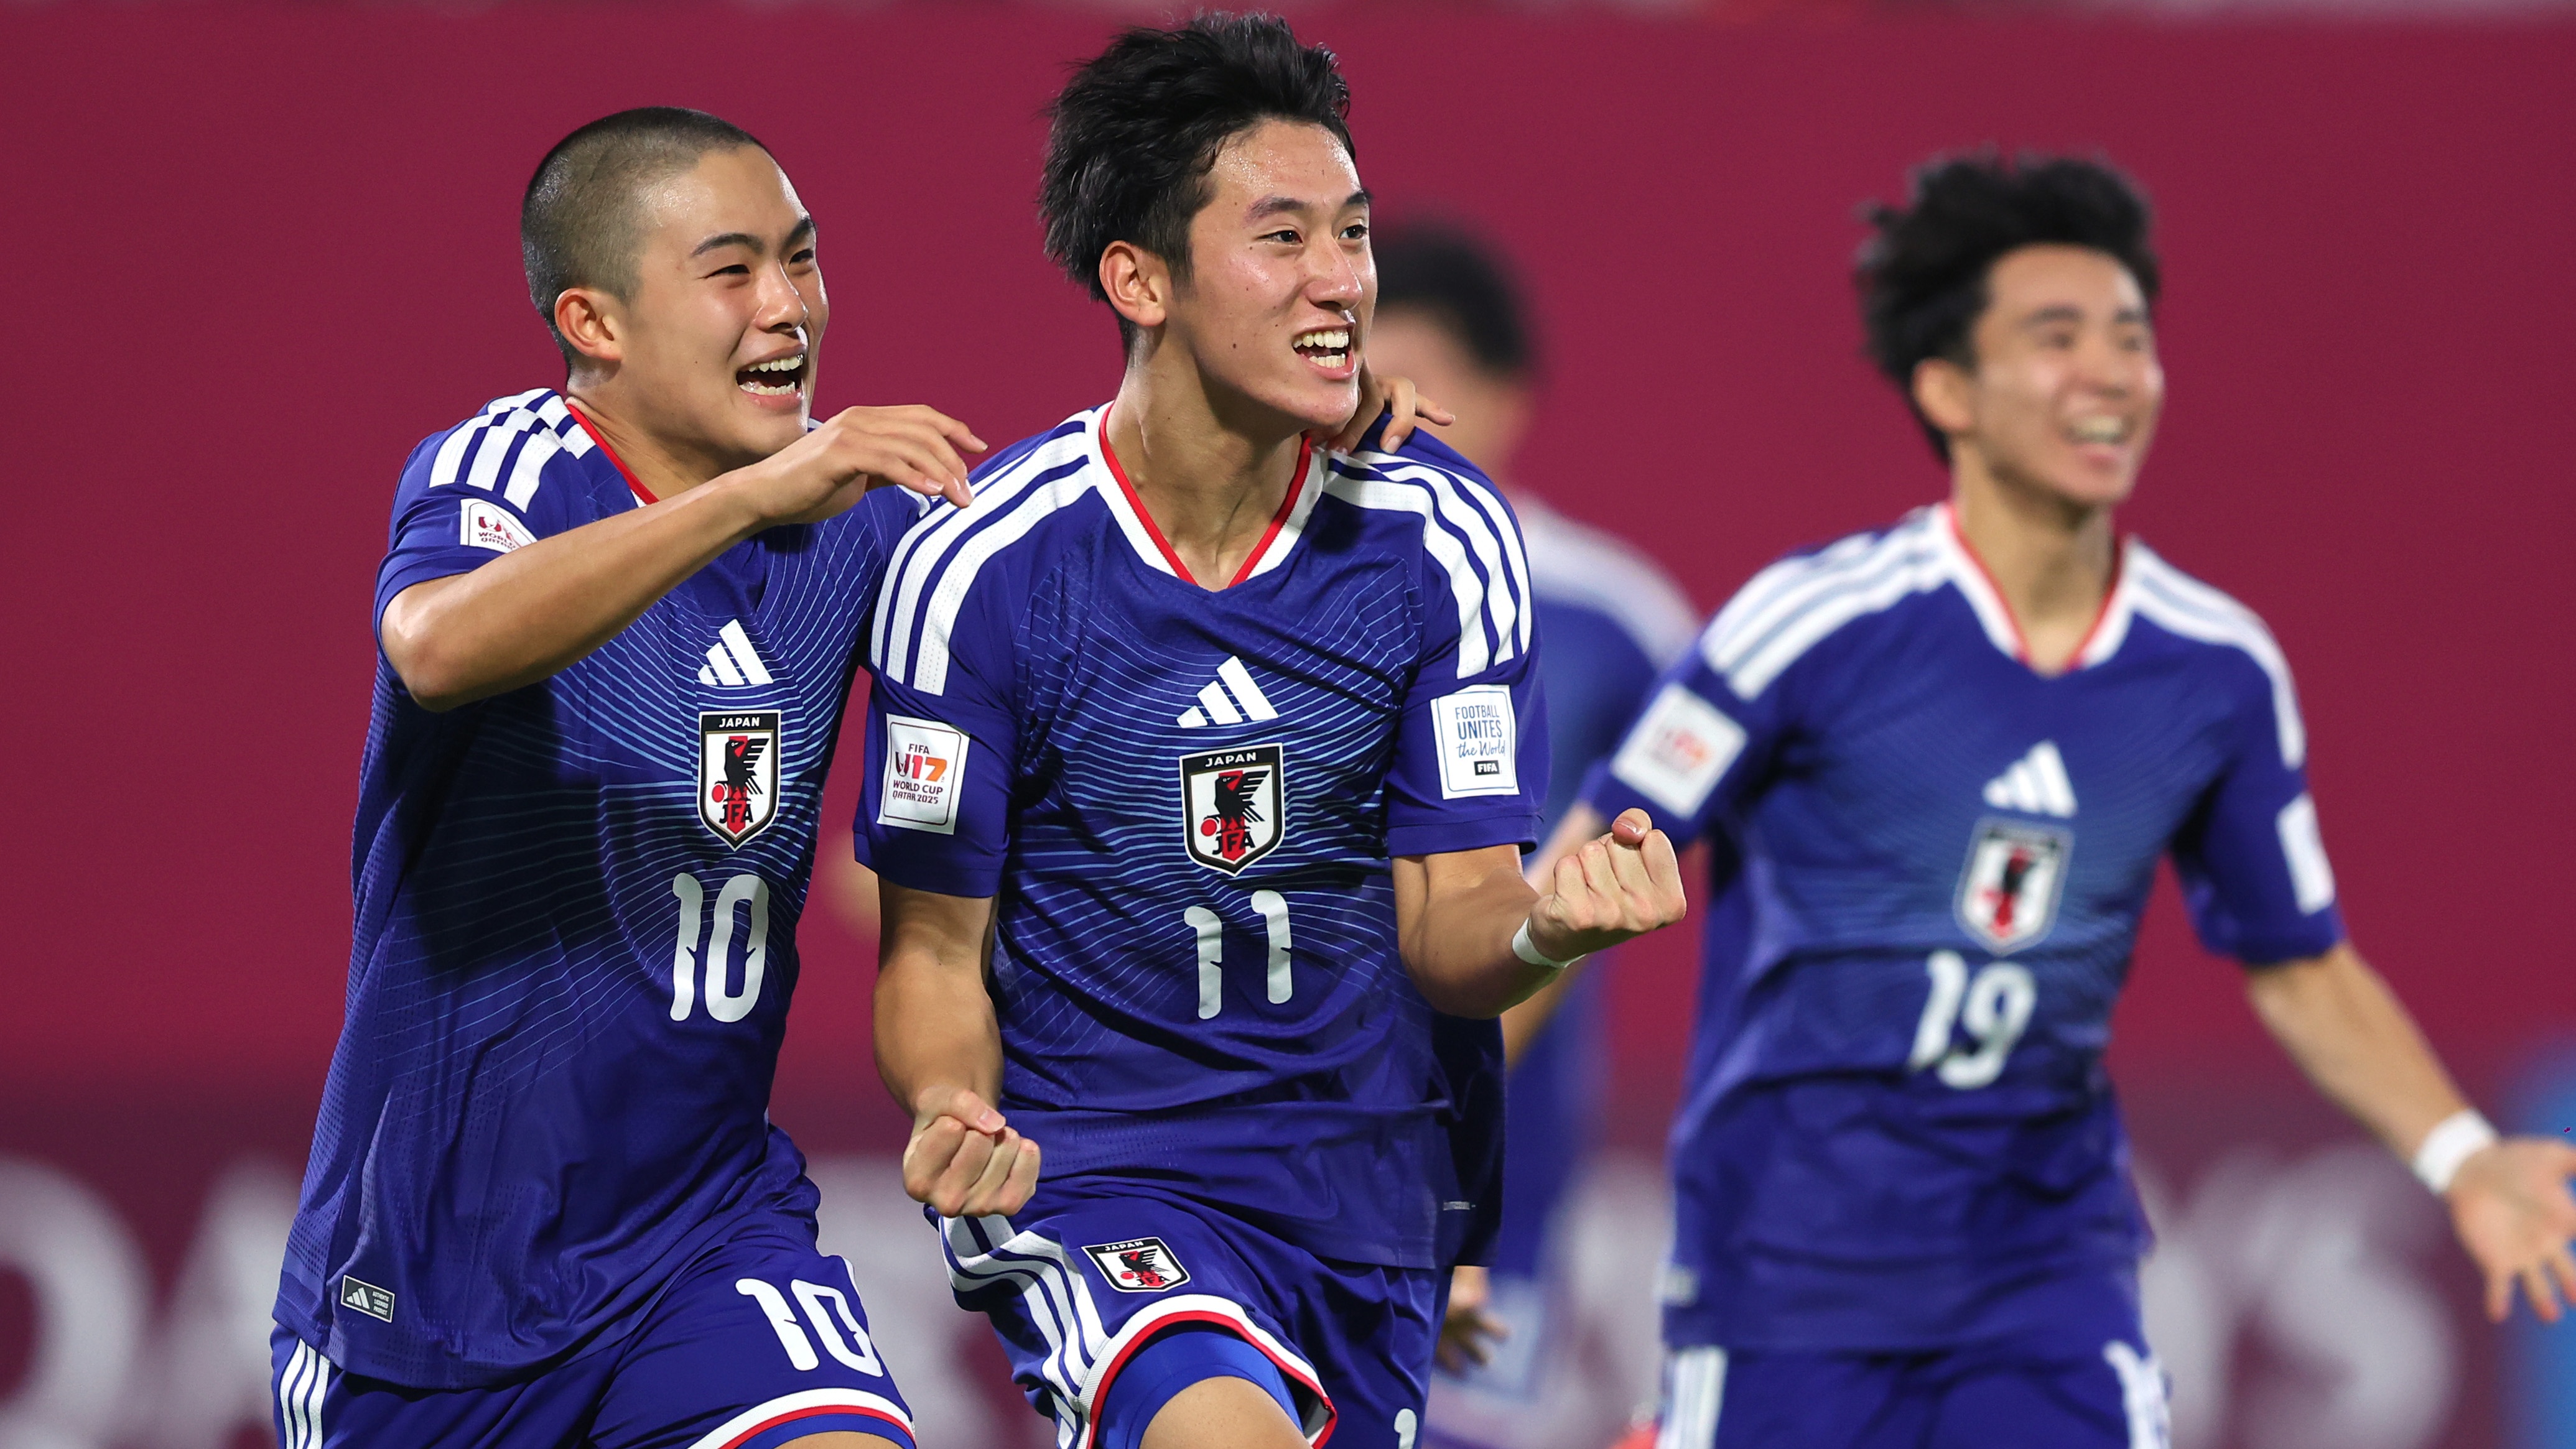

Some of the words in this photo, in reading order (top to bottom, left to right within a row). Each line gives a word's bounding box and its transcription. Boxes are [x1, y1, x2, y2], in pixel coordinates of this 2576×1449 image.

[1455, 705, 1500, 720] FOOTBALL
[718, 717, 760, 728] JAPAN
[1457, 720, 1502, 740] UNITES
[908, 743, 929, 754] FIFA
[1456, 741, 1477, 758] the
[1479, 739, 1505, 757] World
[895, 751, 947, 782] U17
[1205, 752, 1257, 767] JAPAN
[1477, 763, 1498, 773] FIFA
[893, 779, 920, 792] WORLD
[922, 784, 943, 795] CUP
[893, 790, 916, 801] QATAR
[917, 794, 939, 804] 2025
[718, 803, 754, 824] JFA
[1212, 831, 1257, 855] JFA
[670, 873, 769, 1022] 10
[1184, 889, 1293, 1020] 11
[1907, 948, 2038, 1090] 19
[1105, 1241, 1144, 1251] JAPAN
[735, 1278, 884, 1377] 10
